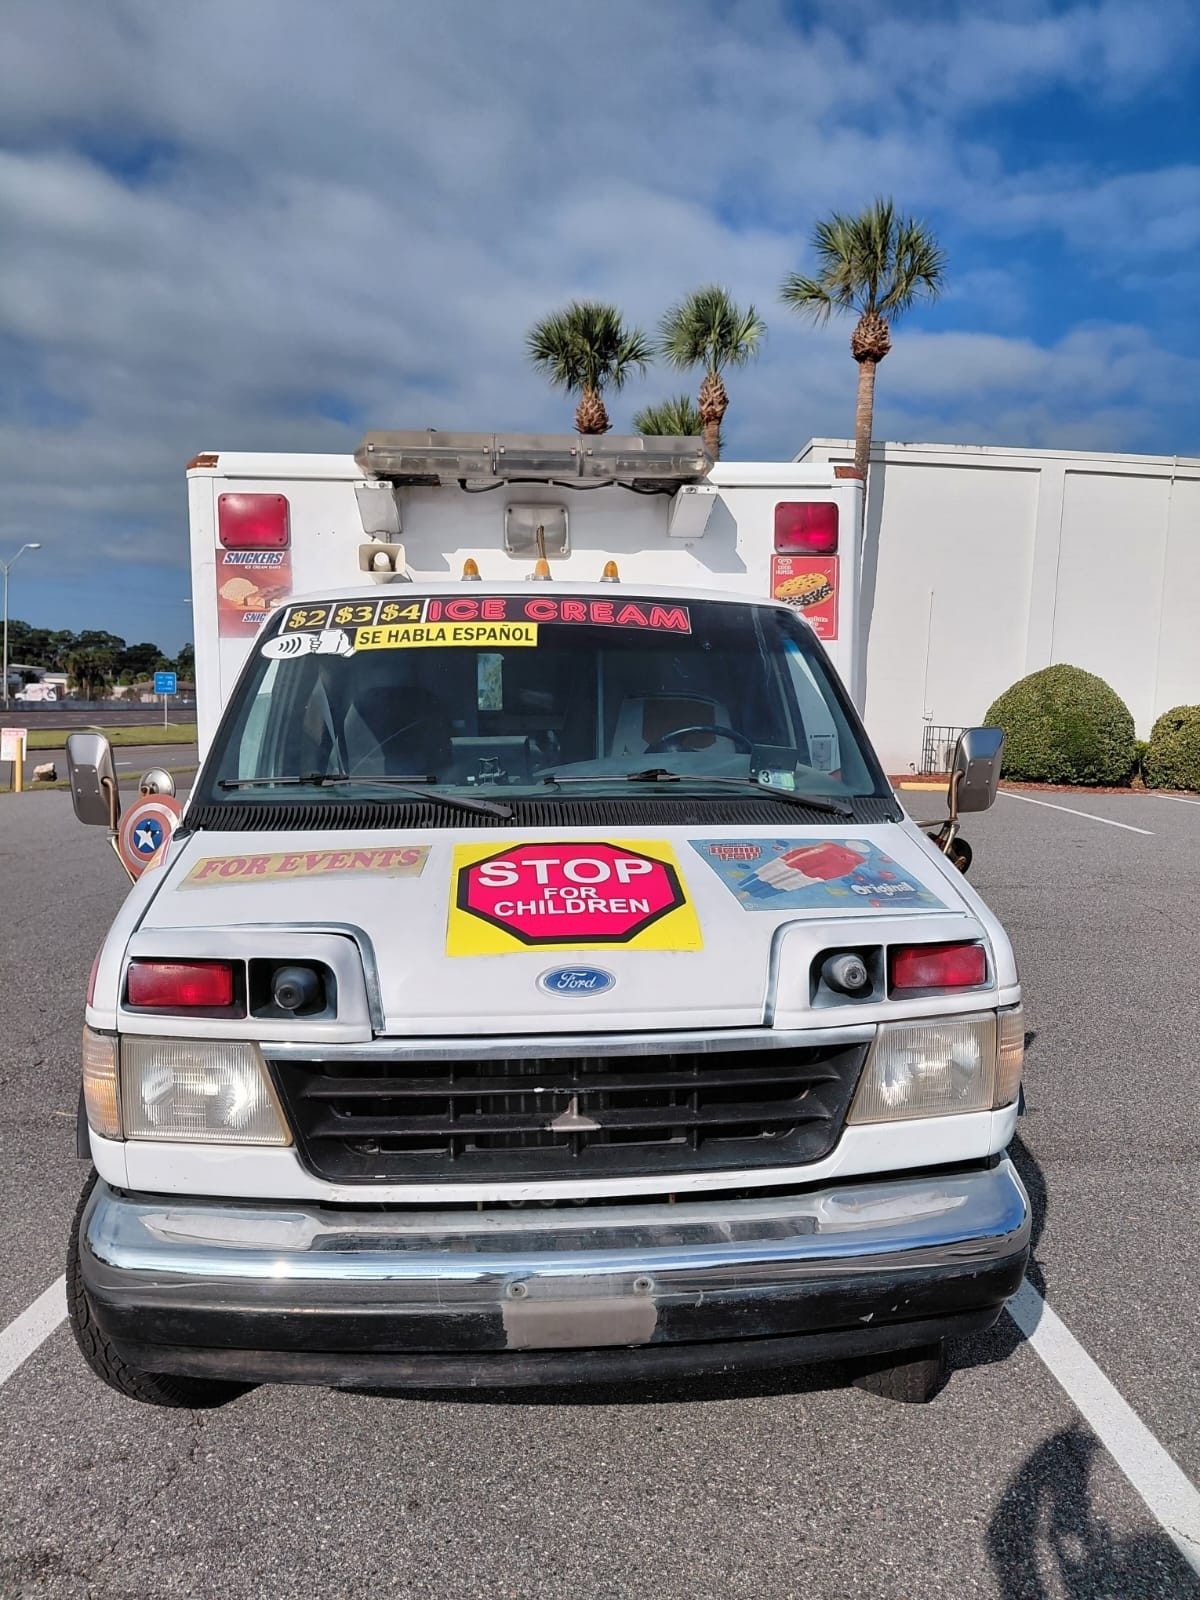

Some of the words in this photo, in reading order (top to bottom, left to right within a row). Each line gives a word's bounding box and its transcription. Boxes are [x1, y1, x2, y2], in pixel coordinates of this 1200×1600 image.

[223, 552, 283, 564] SNICKERS
[289, 609, 327, 629] $2
[335, 605, 373, 625] $3
[380, 603, 421, 621] $4
[429, 600, 506, 621] ICE
[524, 601, 690, 630] CREAM
[360, 630, 382, 645] SE
[387, 627, 446, 644] HABLA
[453, 624, 534, 642] ESPAÑOL
[762, 770, 770, 783] 3
[193, 857, 272, 880] FOR
[275, 849, 421, 873] EVENTS
[478, 858, 653, 887] STOP
[544, 887, 598, 899] FOR
[850, 881, 916, 896] Original
[494, 899, 650, 916] CHILDREN
[557, 972, 597, 989] Ford
